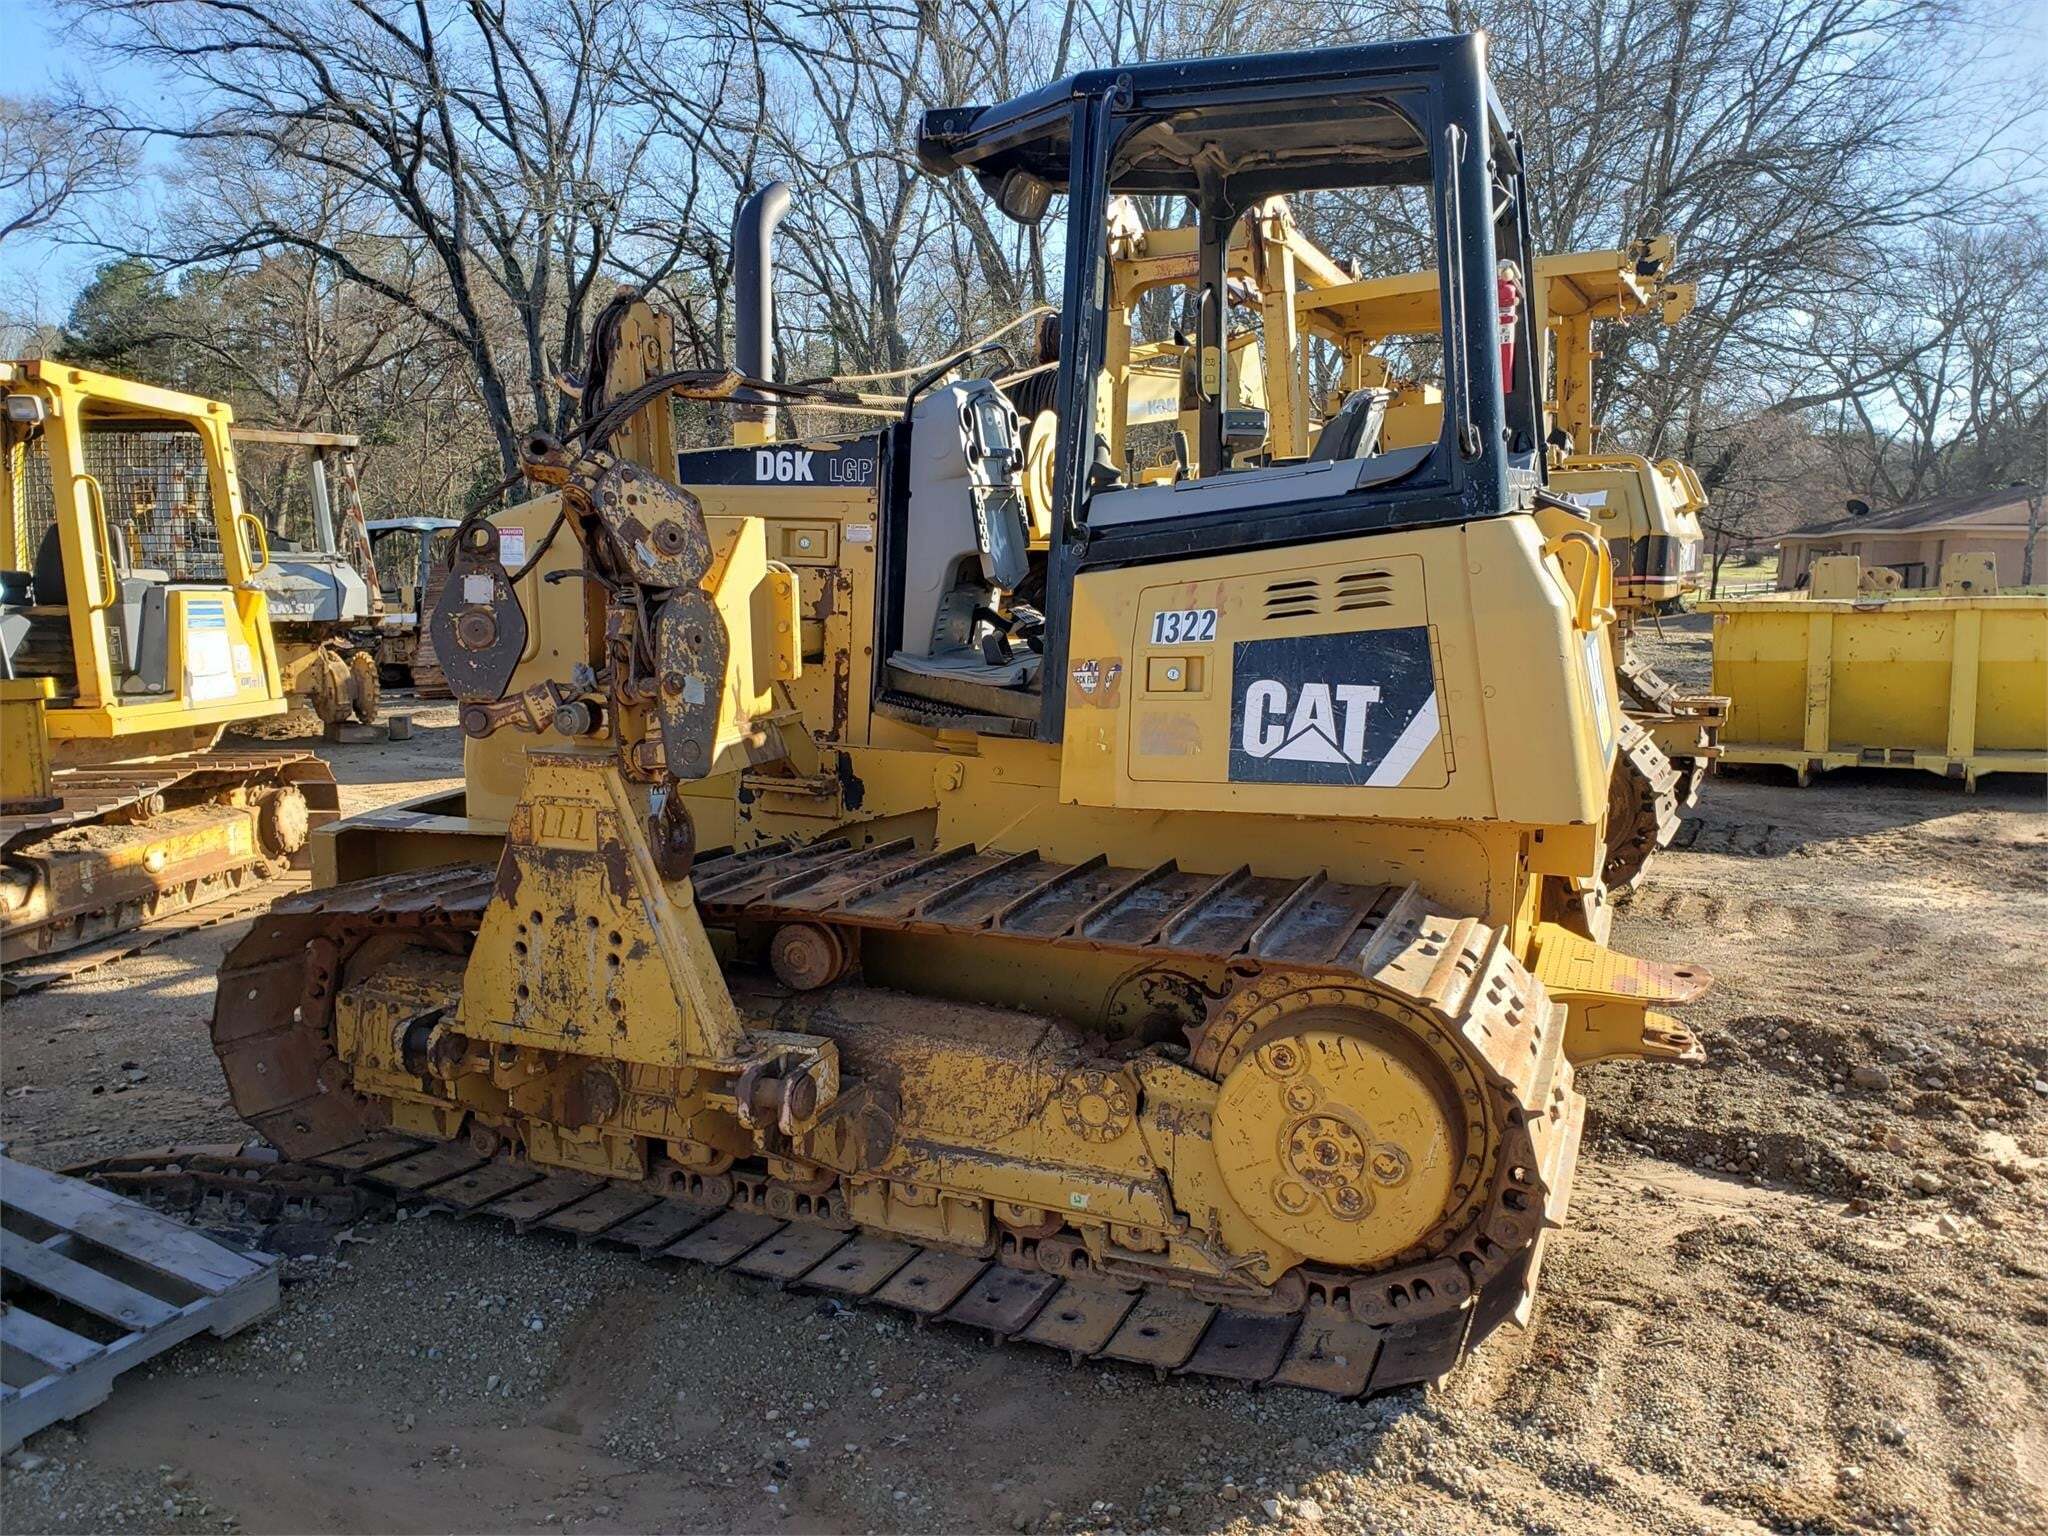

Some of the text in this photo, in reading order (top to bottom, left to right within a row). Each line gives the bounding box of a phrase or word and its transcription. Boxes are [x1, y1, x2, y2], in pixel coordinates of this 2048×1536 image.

[755, 450, 873, 482] D6K LGP
[1154, 609, 1217, 643] 1322
[1242, 679, 1381, 765] CAT
